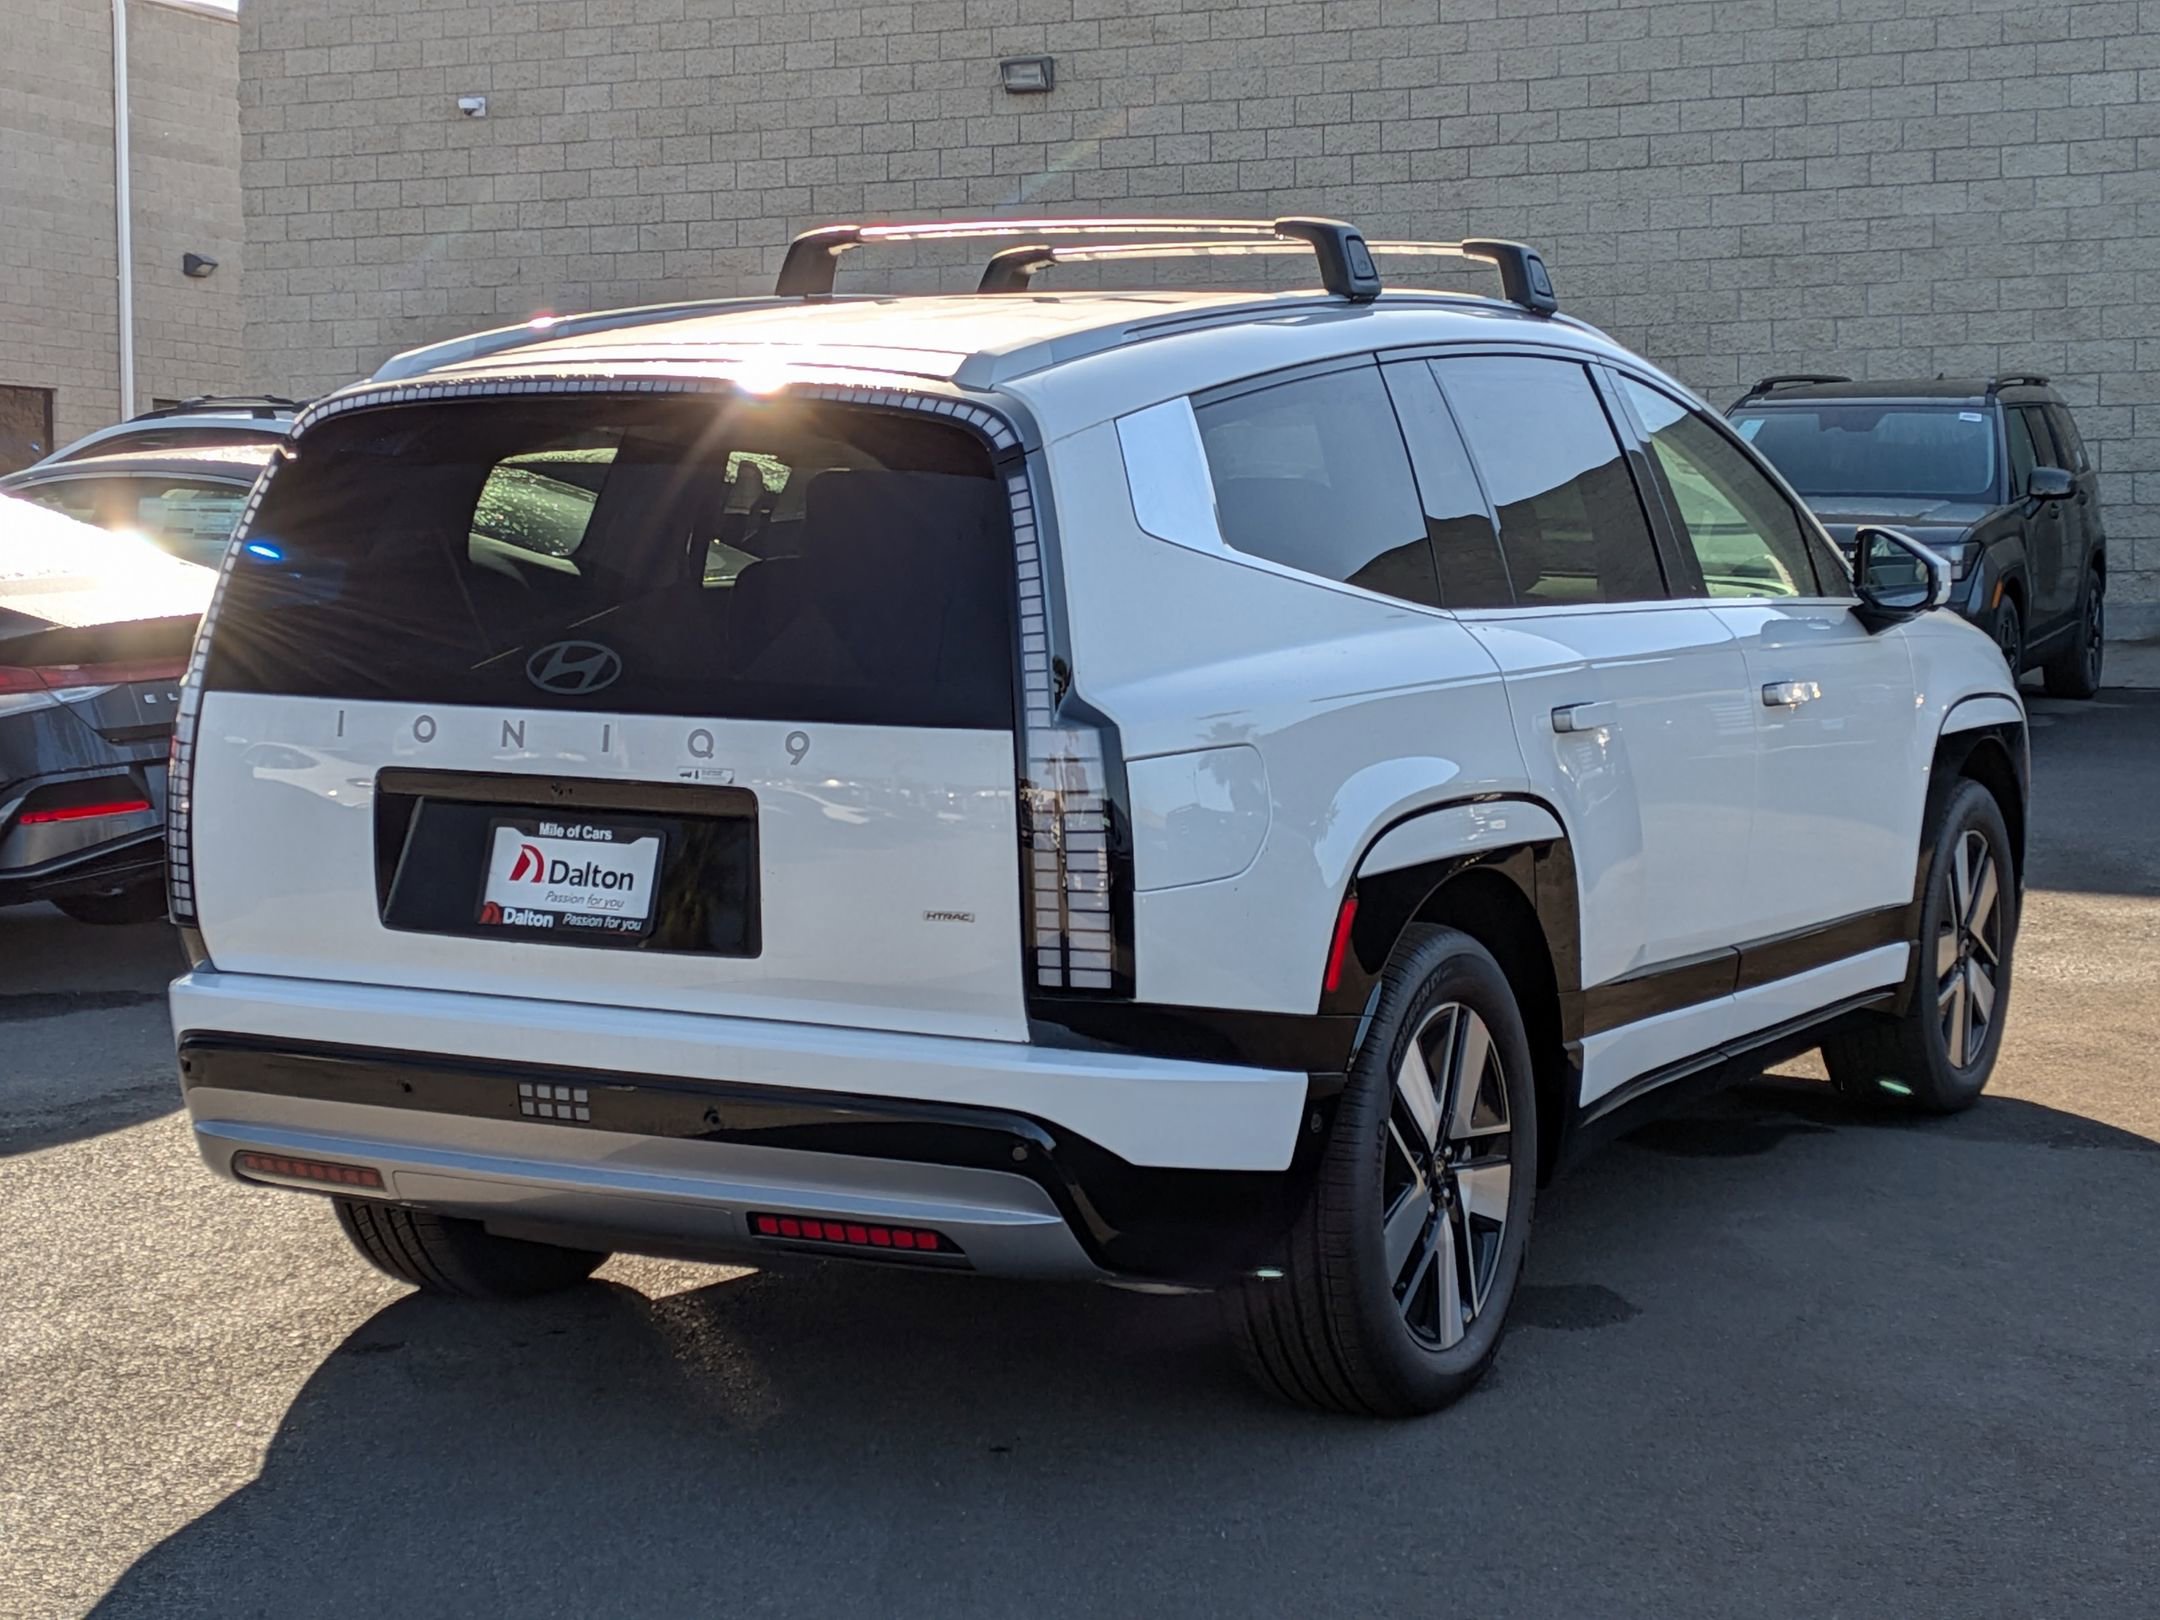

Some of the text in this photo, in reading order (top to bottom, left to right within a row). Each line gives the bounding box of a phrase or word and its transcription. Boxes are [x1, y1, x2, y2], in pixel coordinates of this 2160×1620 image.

[539, 822, 613, 841] Mile of Cars
[548, 859, 634, 891] Dalton
[545, 890, 625, 909] Passion for you
[502, 907, 642, 932] Dalton Passion for you
